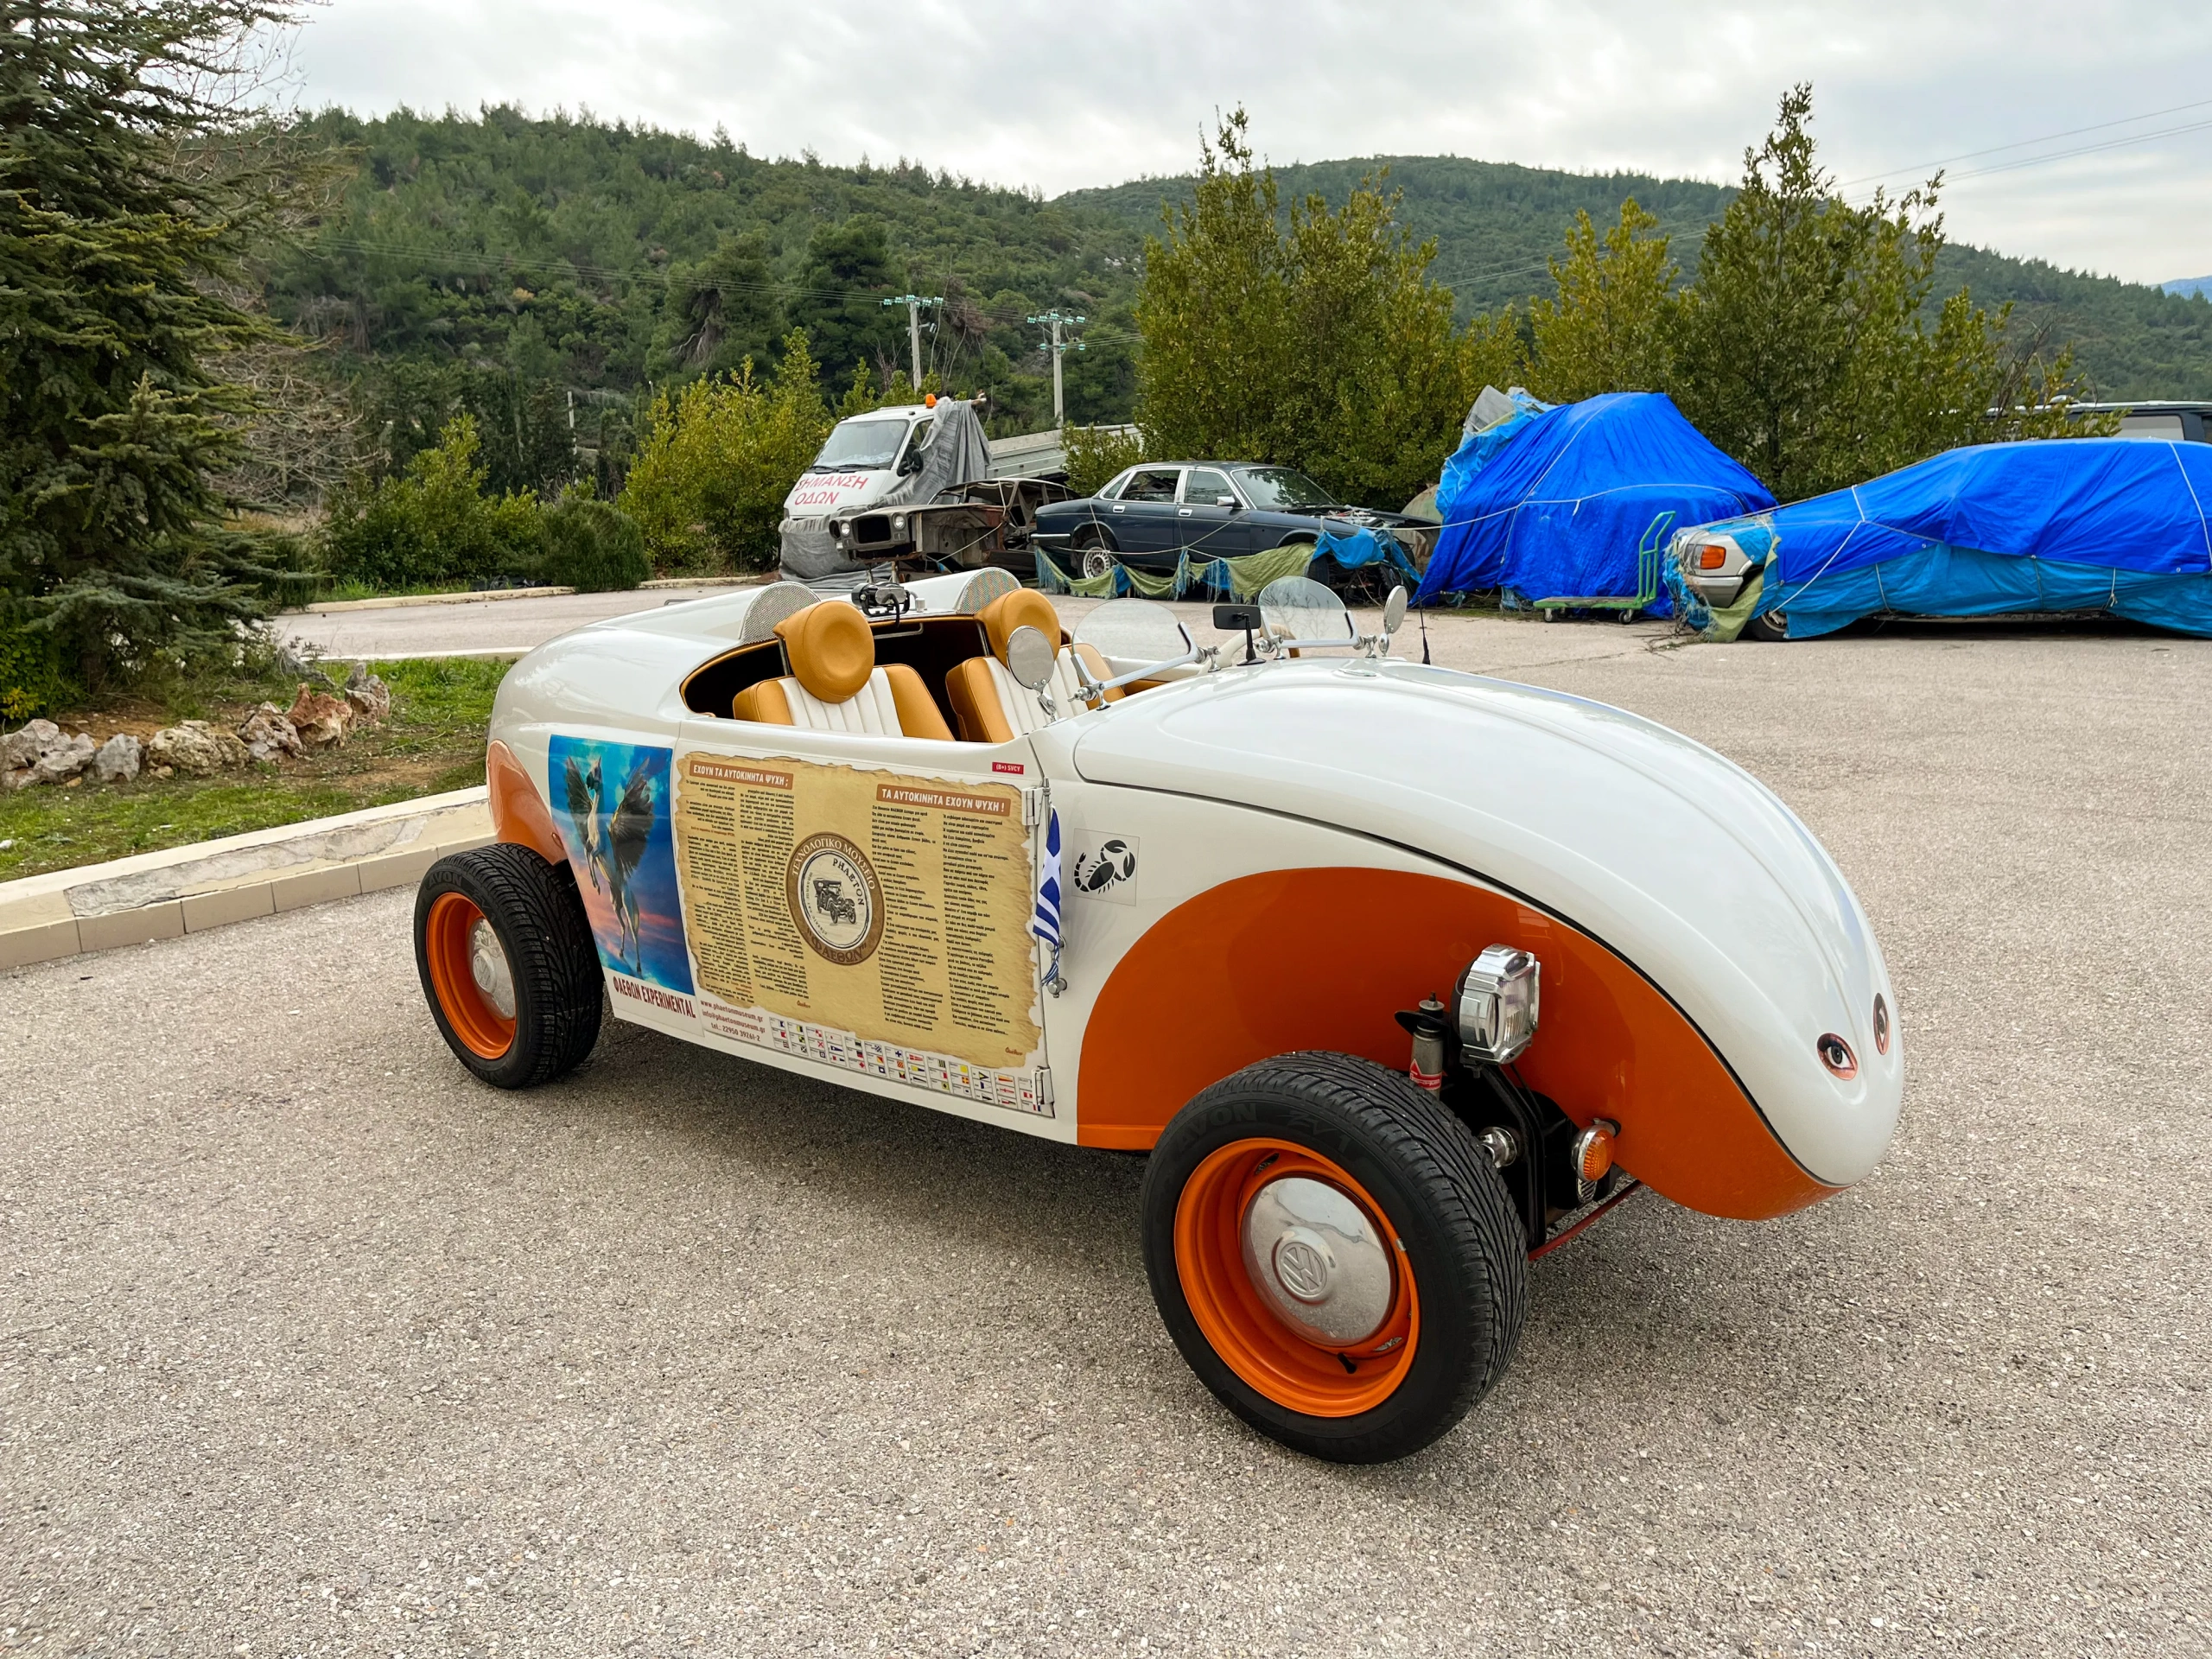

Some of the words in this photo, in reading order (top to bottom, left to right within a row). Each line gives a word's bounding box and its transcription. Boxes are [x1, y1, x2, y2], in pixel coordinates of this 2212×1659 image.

[794, 475, 868, 492] ΣΗΜΑΝΣΗ
[794, 492, 839, 505] ΟΔΩΝ
[693, 764, 714, 776] ΕΧΟΥΝ
[715, 767, 723, 777] ΤΑ
[724, 769, 764, 783] ΑΥΤΟΚΙΝΗΤΑ
[765, 774, 785, 785] ΨΥΧΗ
[881, 788, 892, 799] ΤΑ
[893, 790, 944, 805] ΑΥΤΟΚΙΝΗΤΑ
[945, 796, 973, 809] ΕΧΟΥΝ
[975, 800, 1000, 811] ΨΥΧΗ
[792, 838, 842, 876] ΤΕΧΝΟΛΟΓΙΚΟ
[843, 843, 875, 890] ΜΟΥΣΕΙΟ
[832, 857, 865, 906] PHAETON
[613, 976, 642, 1001] ΦΑΕΘΩΝ
[641, 985, 696, 1019] EXPERIMENTAL
[700, 1000, 764, 1022] www.phaetonmuseum.gr
